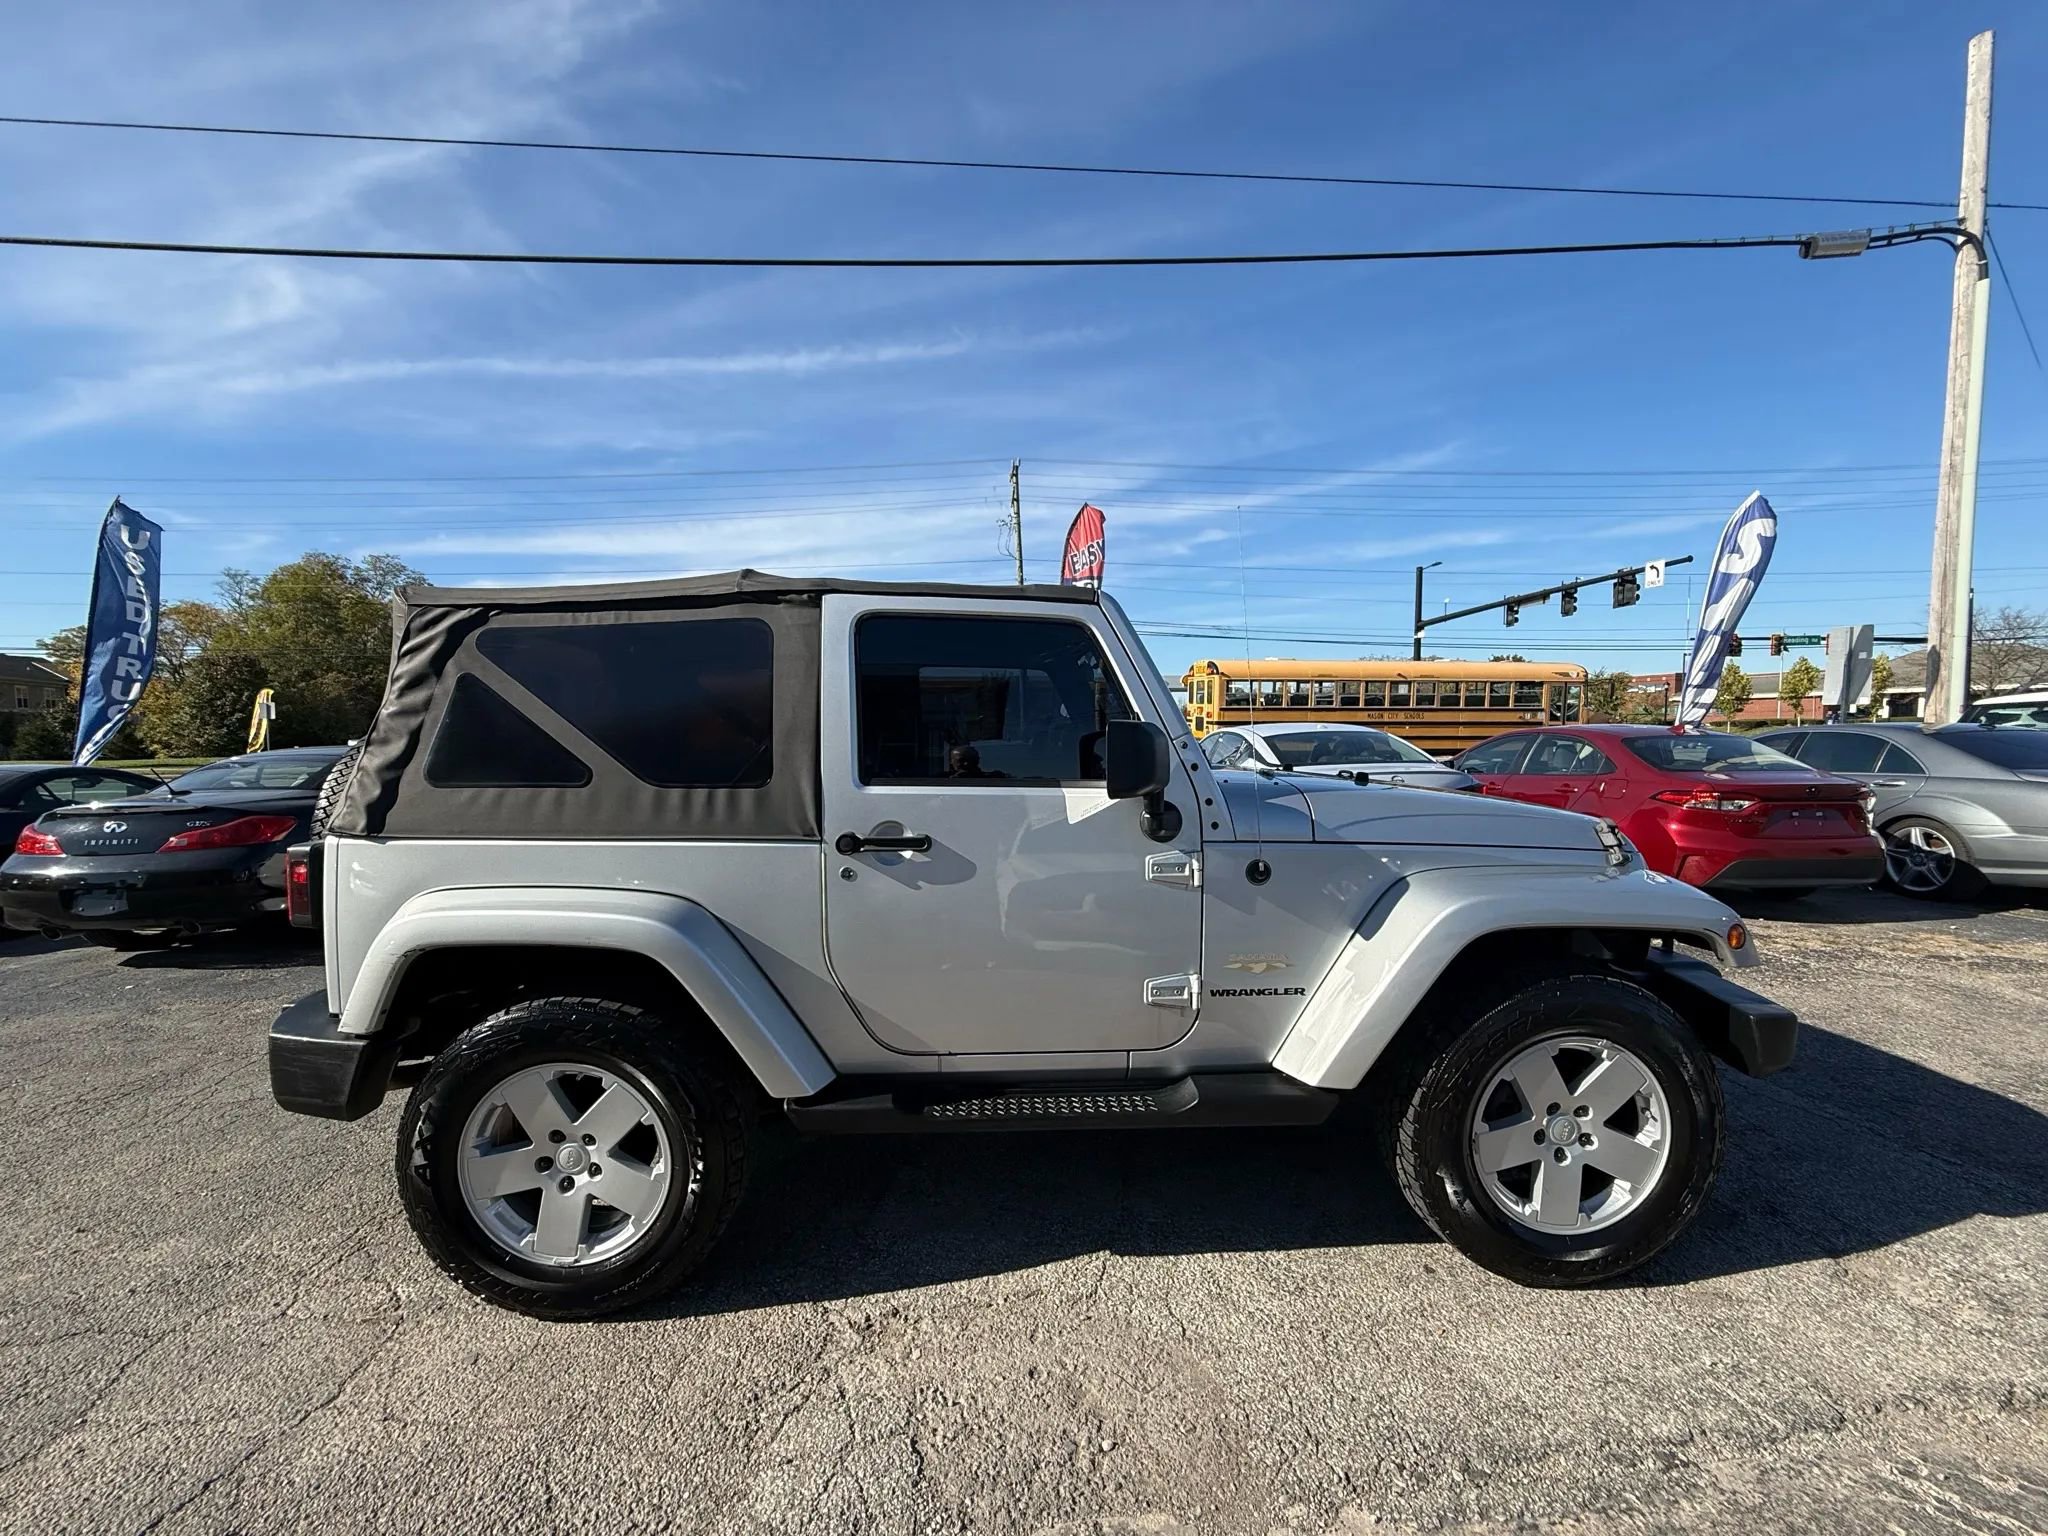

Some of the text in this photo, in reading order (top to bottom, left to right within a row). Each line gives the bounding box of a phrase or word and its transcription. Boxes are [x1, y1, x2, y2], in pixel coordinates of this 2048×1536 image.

[1069, 539, 1104, 576] EASY
[120, 524, 152, 626] USED
[1367, 712, 1425, 720] MASON CITY SCHOOLS
[84, 838, 139, 846] INFINITI
[1209, 987, 1307, 998] WRANGLER
